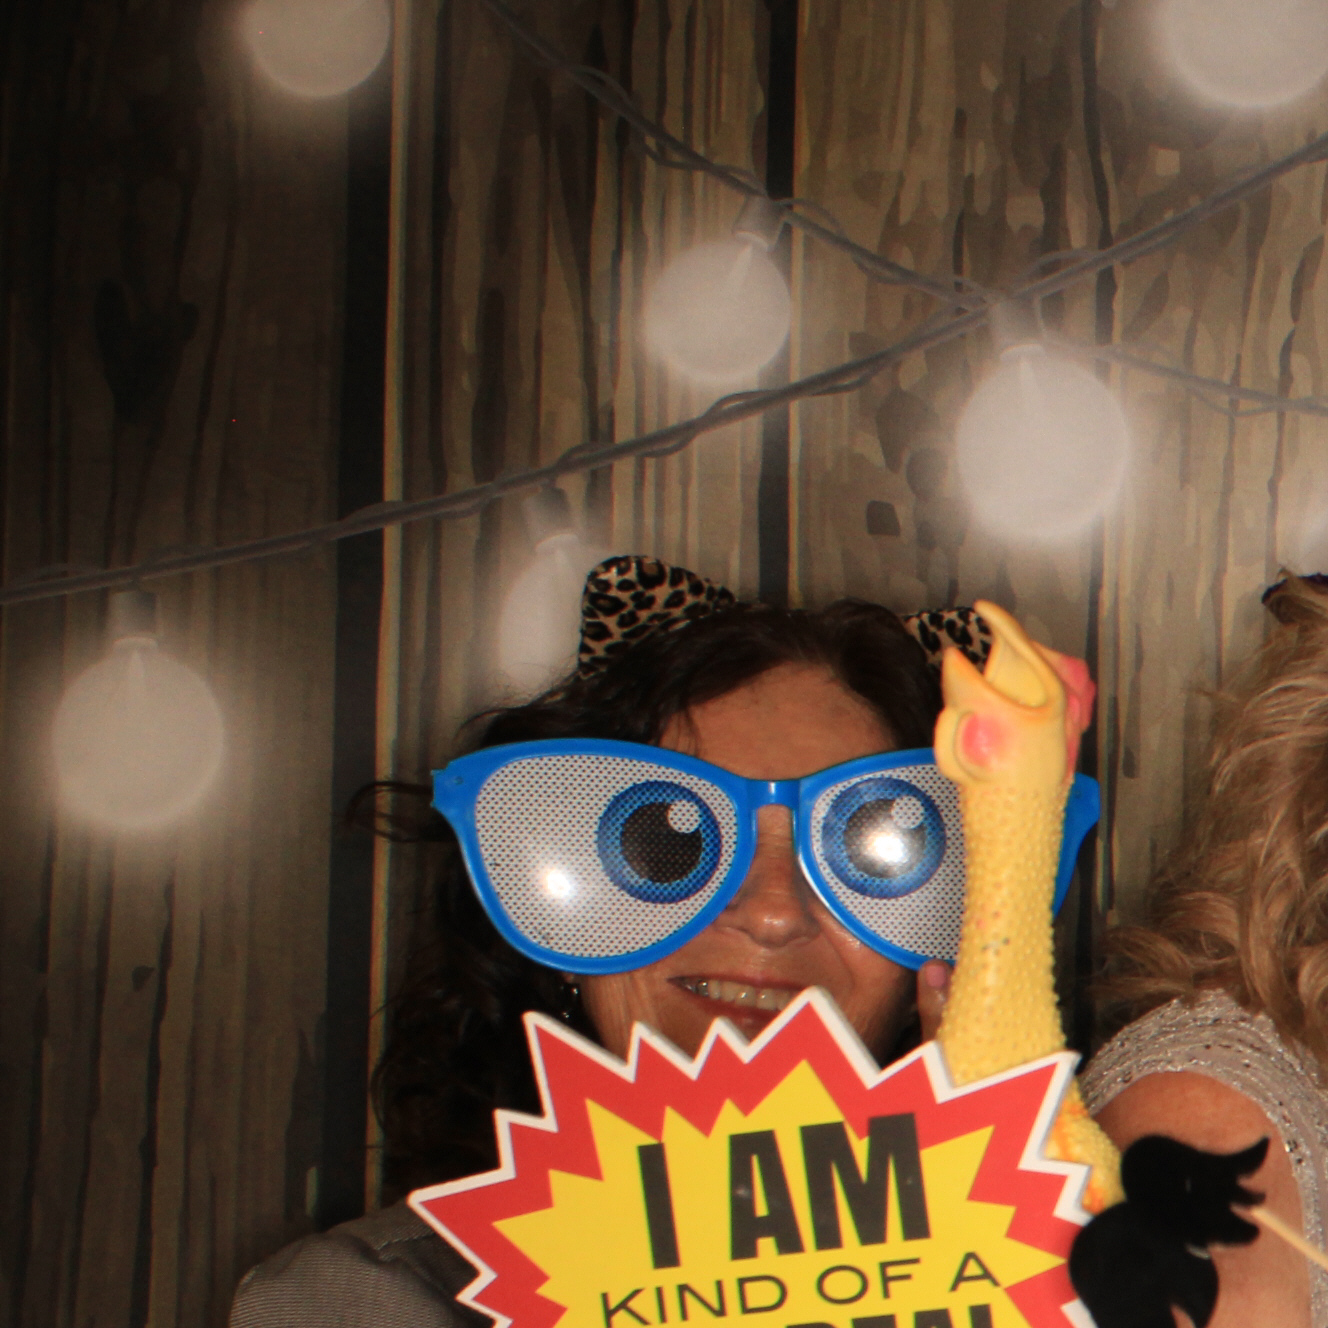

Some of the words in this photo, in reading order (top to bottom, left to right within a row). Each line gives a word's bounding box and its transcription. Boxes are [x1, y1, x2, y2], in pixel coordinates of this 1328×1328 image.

[637, 1142, 680, 1269] I
[729, 1112, 931, 1261] AM
[600, 1274, 788, 1328] KIND
[816, 1257, 921, 1305] OF
[950, 1251, 1000, 1292] A
